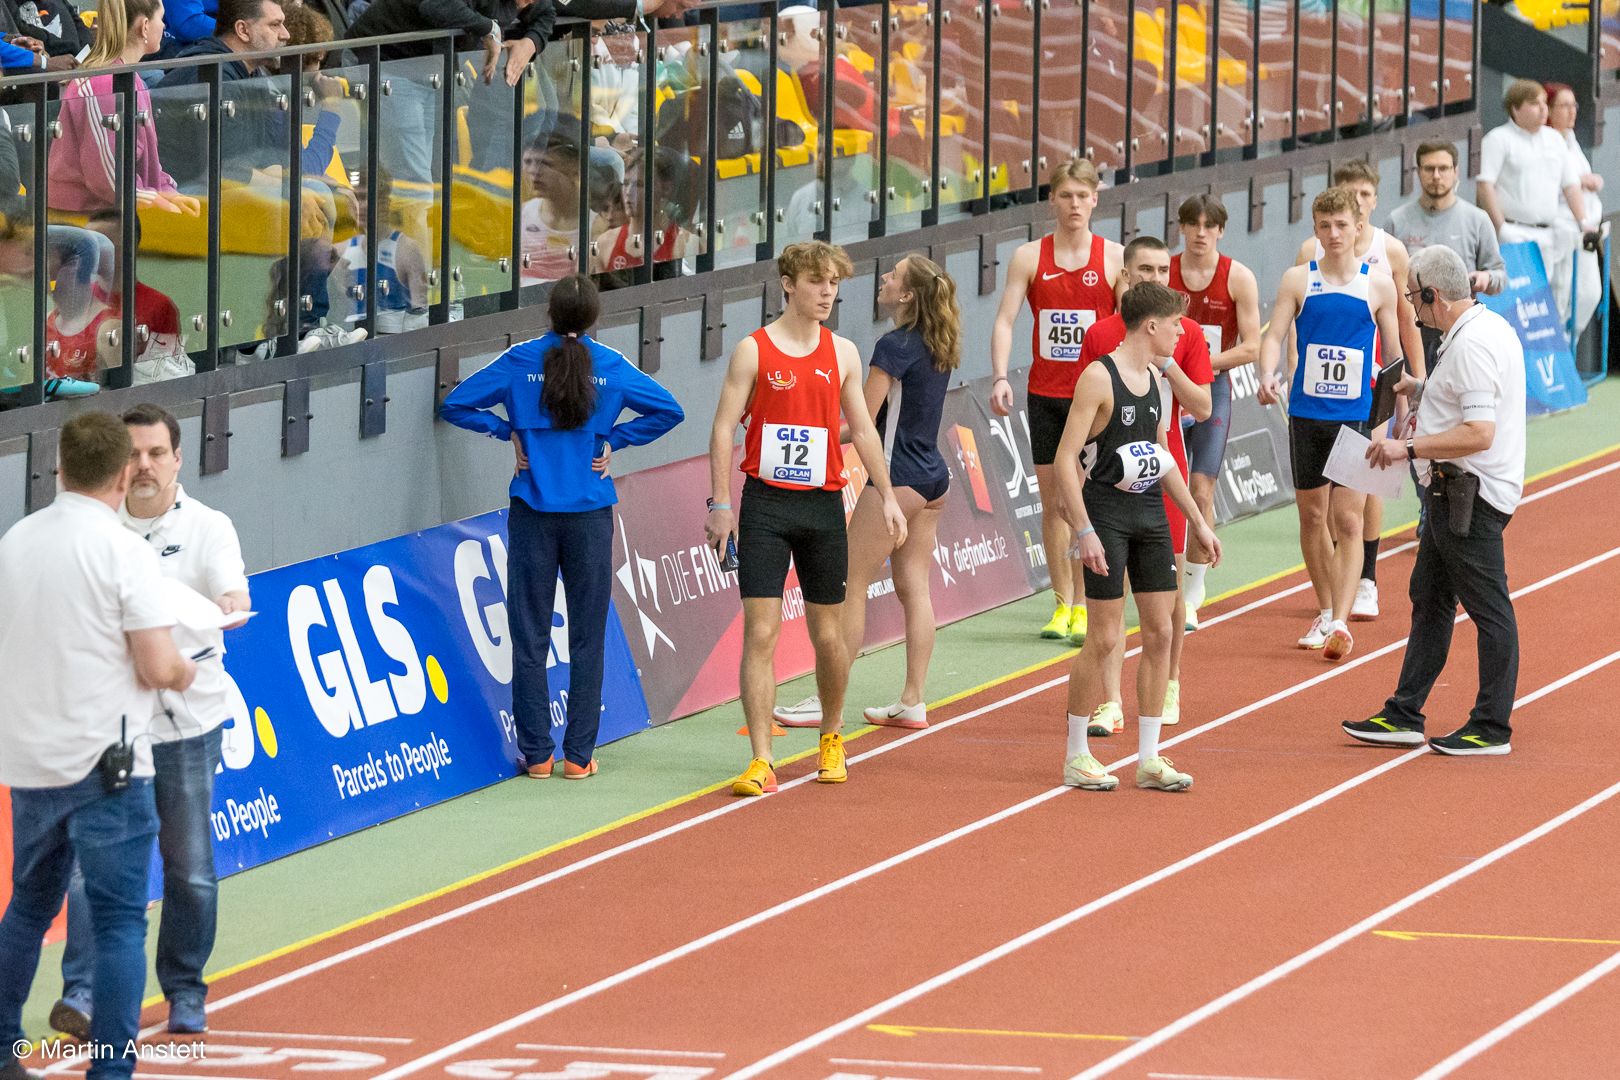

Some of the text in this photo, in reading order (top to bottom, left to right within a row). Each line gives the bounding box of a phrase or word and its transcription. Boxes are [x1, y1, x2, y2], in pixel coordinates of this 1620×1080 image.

[1048, 326, 1085, 344] 450
[527, 374, 536, 382] TV
[767, 371, 782, 380] LG
[1321, 362, 1346, 381] 10
[781, 444, 808, 466] 12
[789, 469, 810, 477] PLAN
[1137, 456, 1160, 479] 29
[661, 550, 697, 605] DIE
[332, 731, 452, 799] Parcels to People
[210, 787, 281, 842] to People
